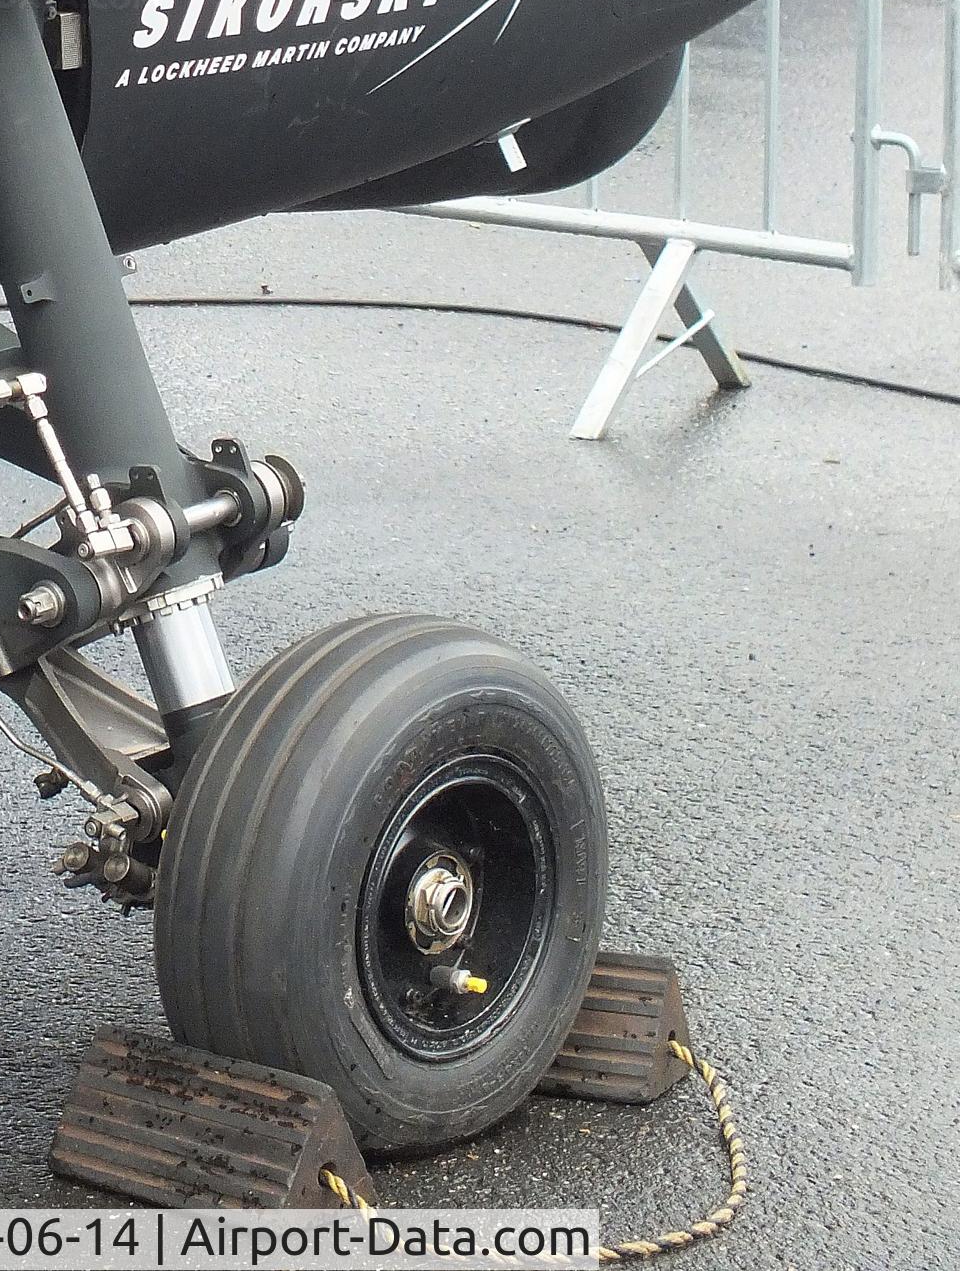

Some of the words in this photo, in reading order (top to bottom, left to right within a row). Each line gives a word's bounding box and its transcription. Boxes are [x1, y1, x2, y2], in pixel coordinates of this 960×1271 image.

[114, 68, 131, 88] A
[137, 53, 246, 85] LOCKHEED
[251, 40, 331, 69] MARTIN
[334, 24, 427, 56] COMPANY
